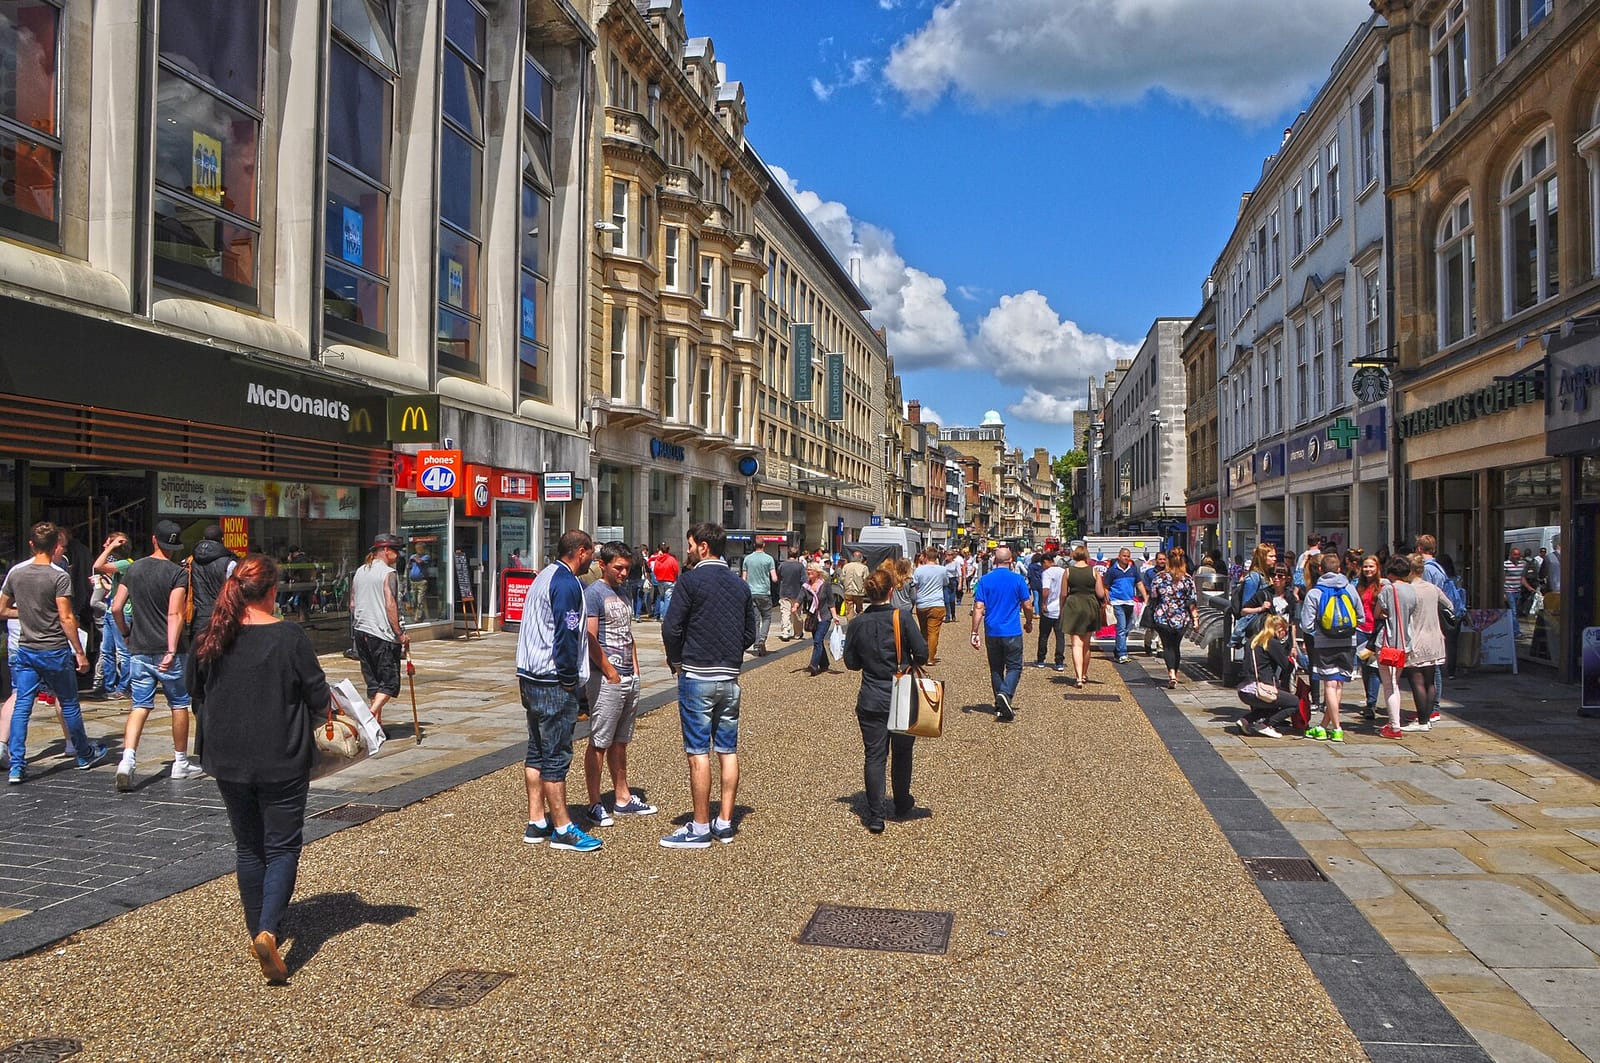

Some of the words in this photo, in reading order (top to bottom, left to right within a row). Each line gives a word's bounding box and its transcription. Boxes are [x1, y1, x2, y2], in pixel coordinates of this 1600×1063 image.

[799, 333, 808, 393] CLARENDON
[247, 382, 350, 422] McDonald's
[1399, 396, 1471, 439] STARBUCKS
[1474, 379, 1536, 418] COFFEE
[424, 456, 454, 464] phones
[161, 478, 204, 494] Smoothies
[174, 495, 207, 512] Frappés
[224, 517, 244, 533] NOW
